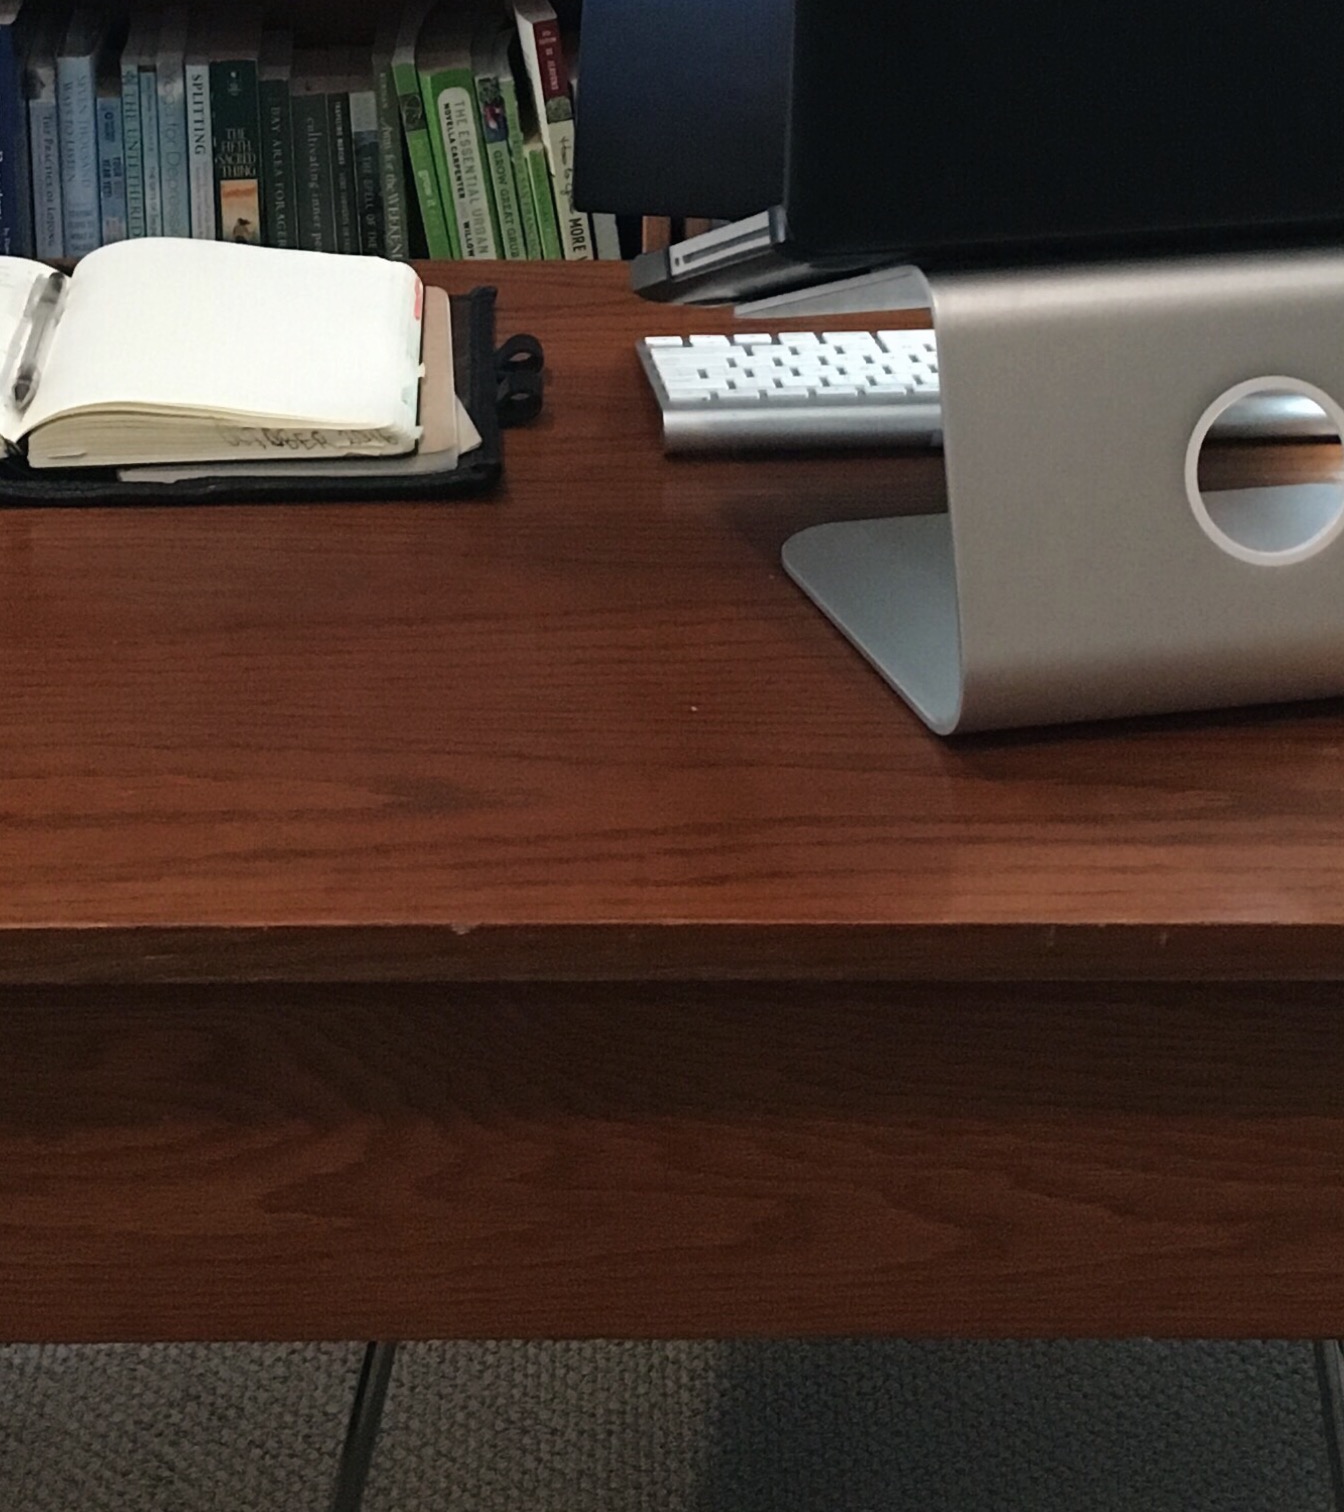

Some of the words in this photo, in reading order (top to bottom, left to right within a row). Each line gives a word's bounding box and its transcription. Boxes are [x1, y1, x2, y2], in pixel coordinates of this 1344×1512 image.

[193, 75, 205, 155] SPLITTING
[493, 151, 506, 185] GROW
[500, 188, 514, 225] GREAT
[508, 228, 519, 258] GRUB
[570, 218, 586, 252] MORE
